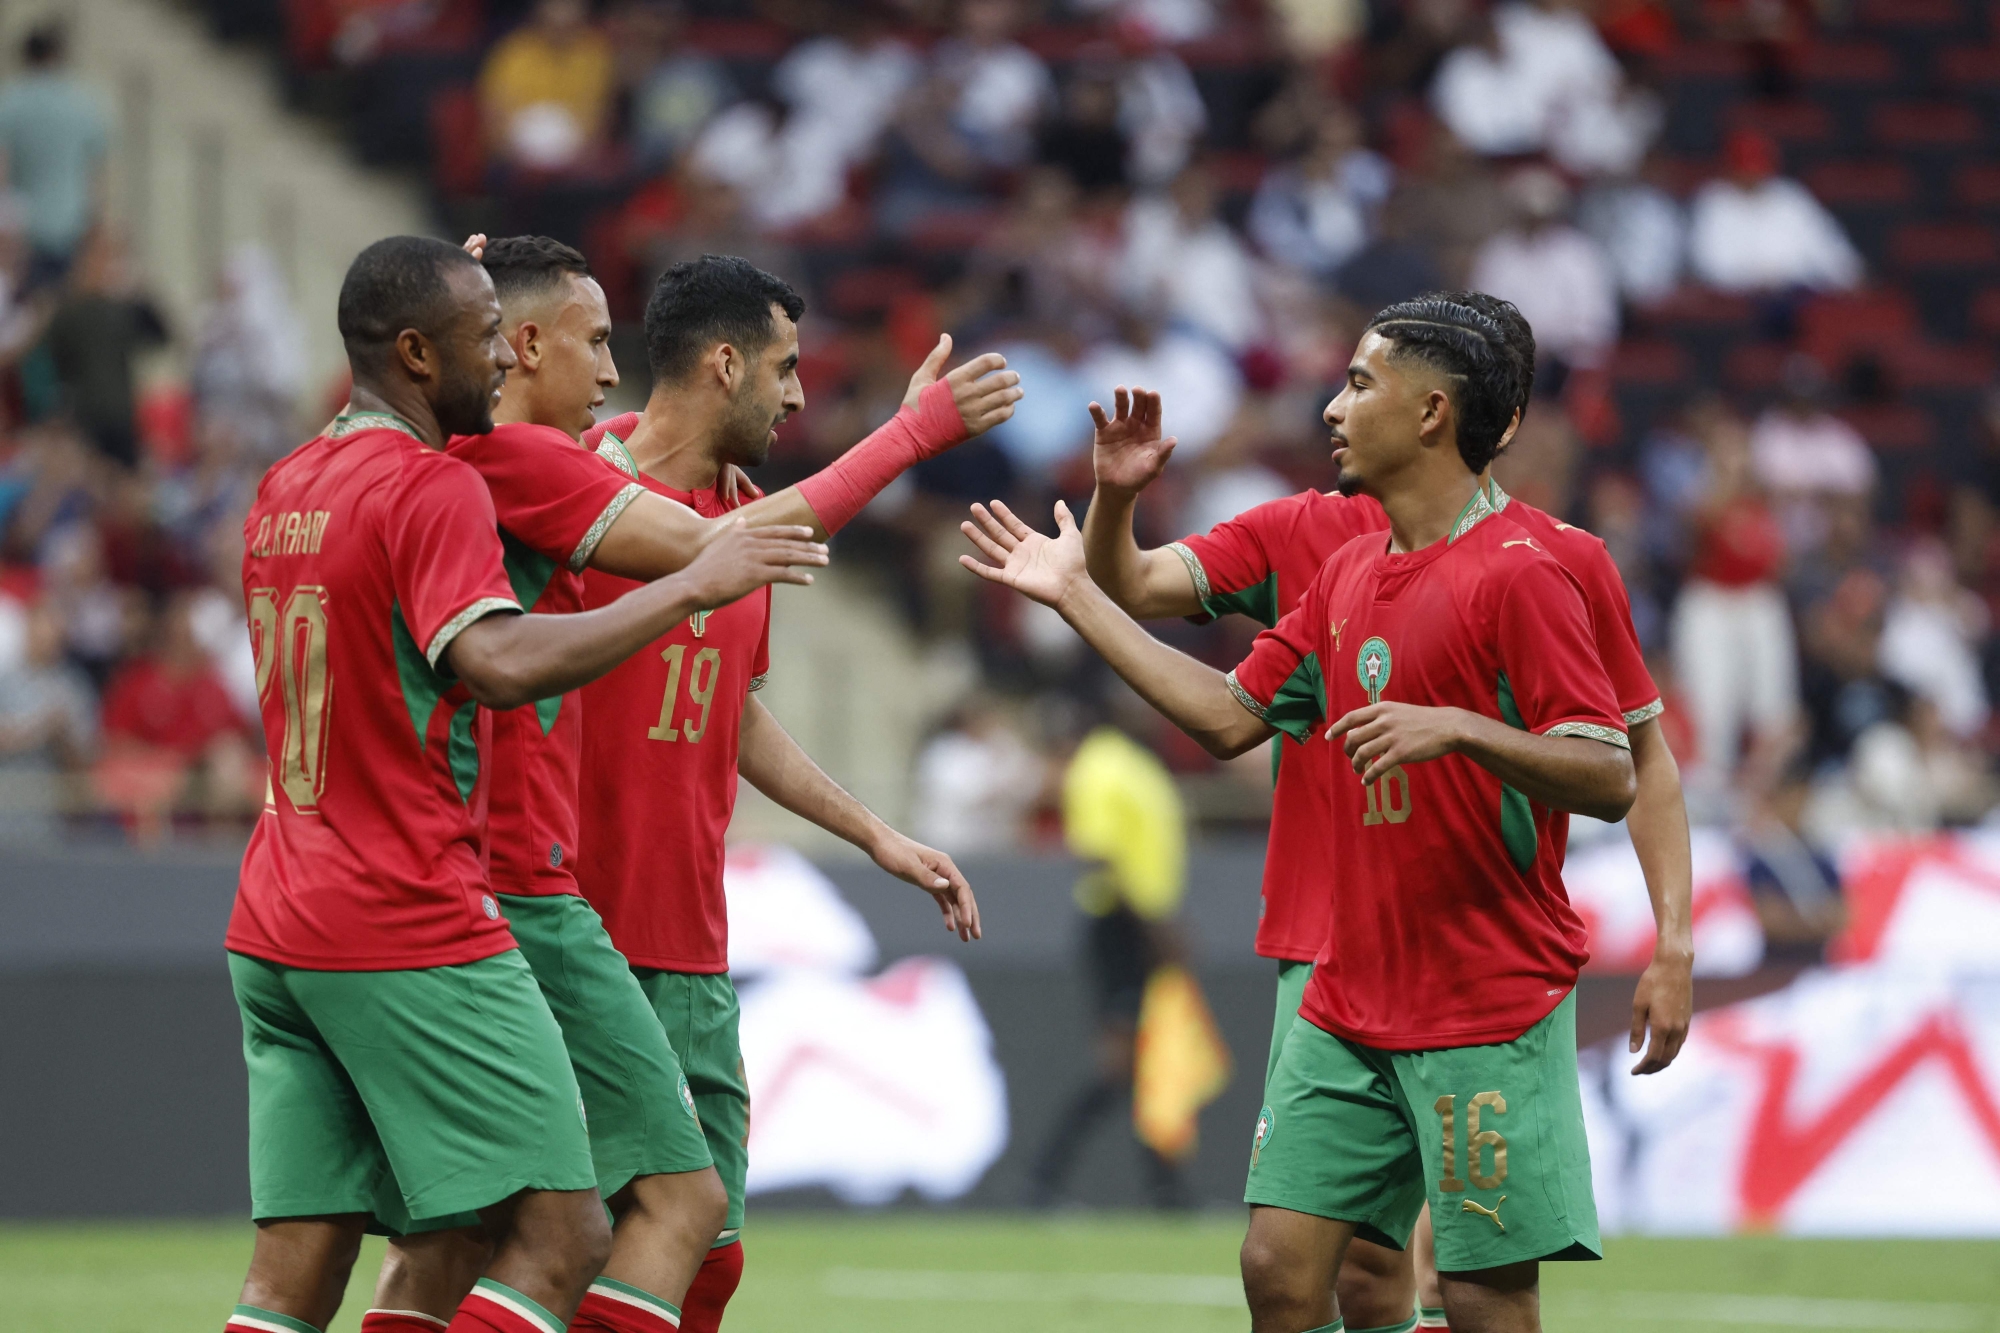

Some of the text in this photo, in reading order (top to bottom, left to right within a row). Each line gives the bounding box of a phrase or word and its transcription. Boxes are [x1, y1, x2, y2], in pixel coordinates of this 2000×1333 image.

[249, 585, 333, 815] 20
[647, 643, 721, 744] 19
[1433, 1090, 1508, 1193] 16
